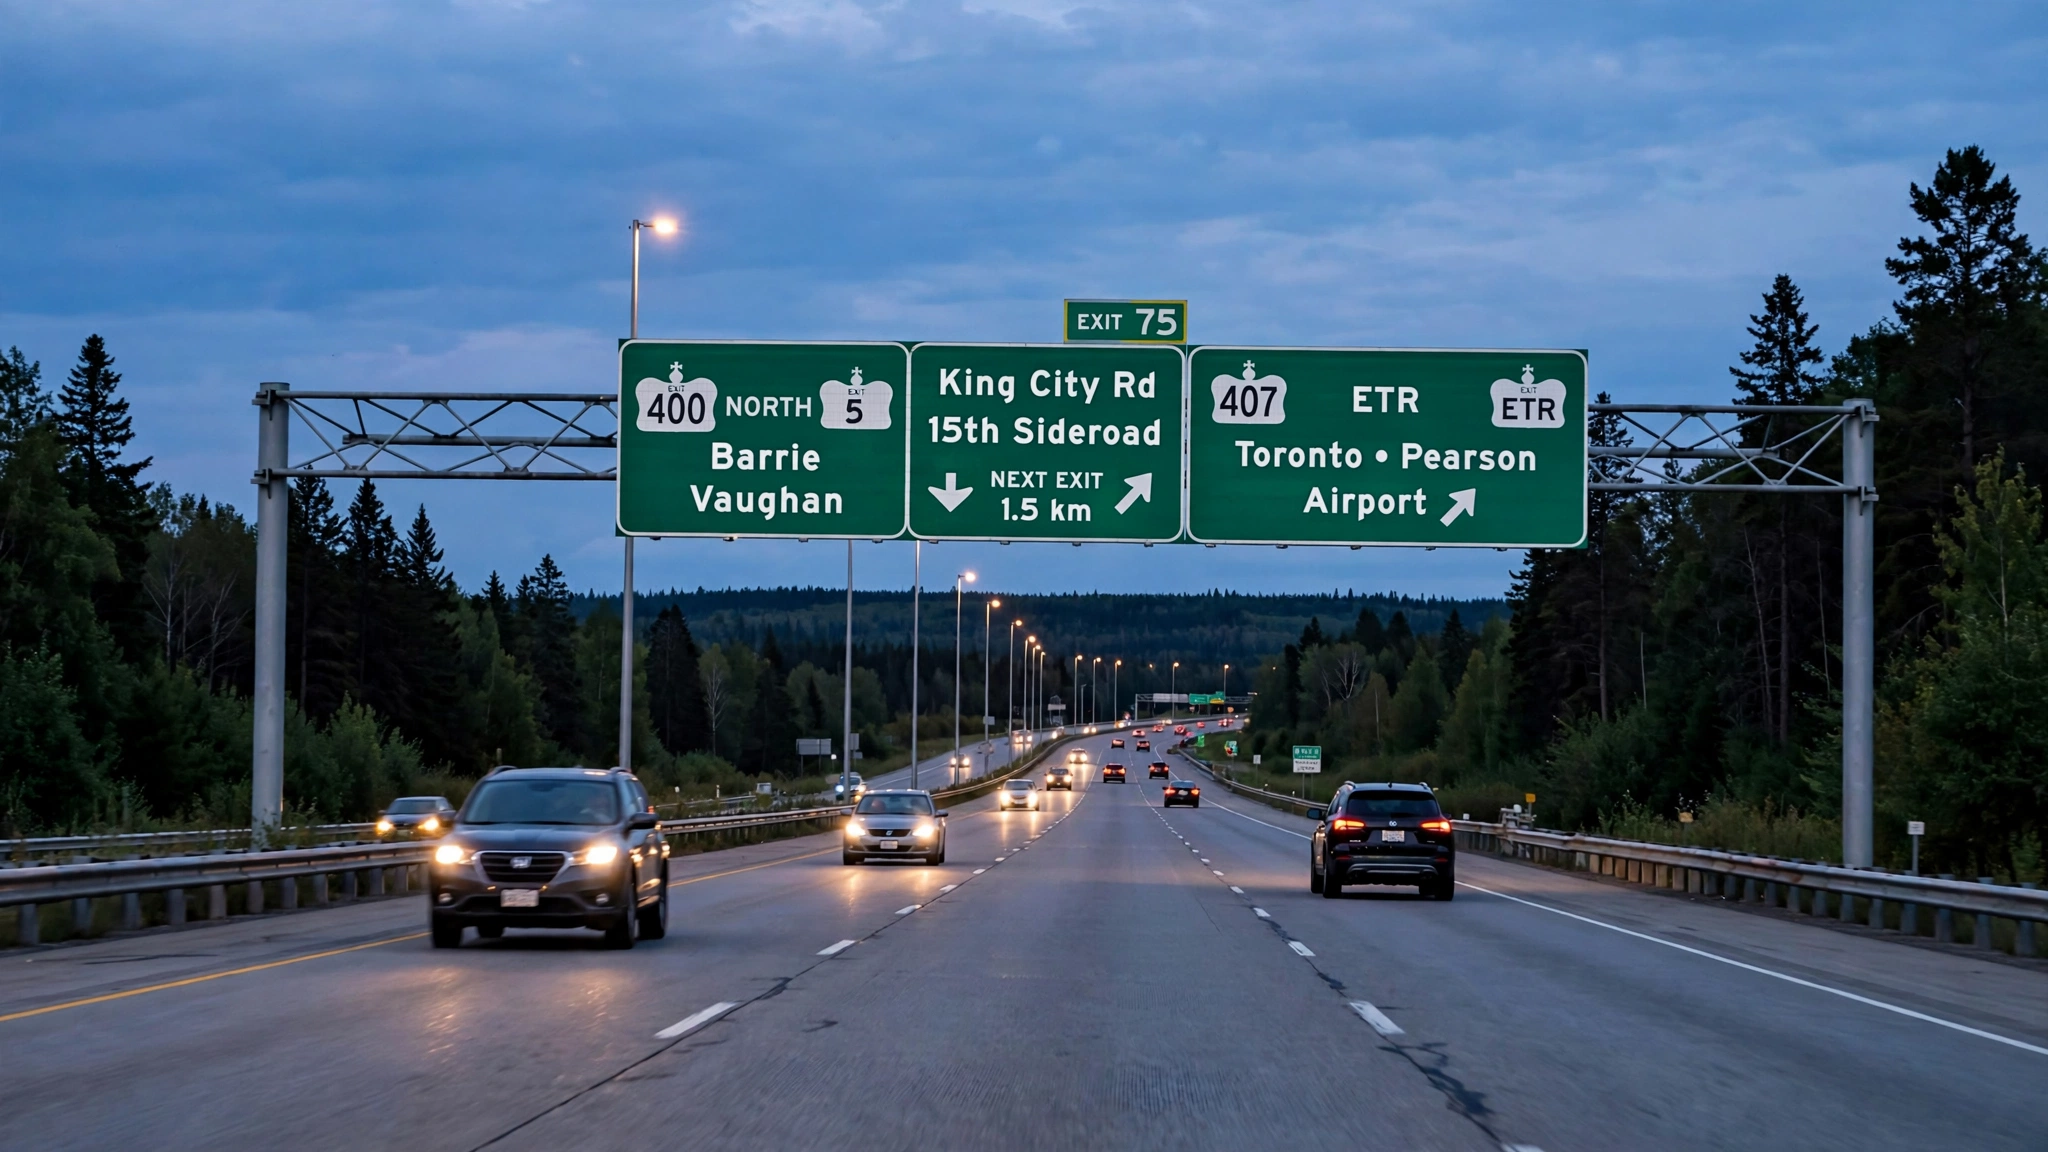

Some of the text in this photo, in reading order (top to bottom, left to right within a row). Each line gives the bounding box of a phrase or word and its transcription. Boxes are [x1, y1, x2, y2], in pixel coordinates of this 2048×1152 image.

[1077, 308, 1177, 336] EXIT 75
[939, 367, 1156, 405] King City Rd
[1219, 384, 1279, 418] 407
[1353, 385, 1419, 413] ETR
[646, 392, 706, 425] 400
[726, 395, 812, 418] NORTH
[845, 398, 864, 425] 5
[1502, 397, 1556, 421] ETR
[928, 415, 1161, 446] 15th Sideroad
[711, 441, 821, 472] Barrie
[1234, 440, 1537, 472] Toronto Pearson
[991, 470, 1104, 489] NEXT EXIT
[689, 484, 843, 521] Vaughan
[1001, 497, 1092, 522] 1.5 km
[1303, 486, 1427, 522] Airport
